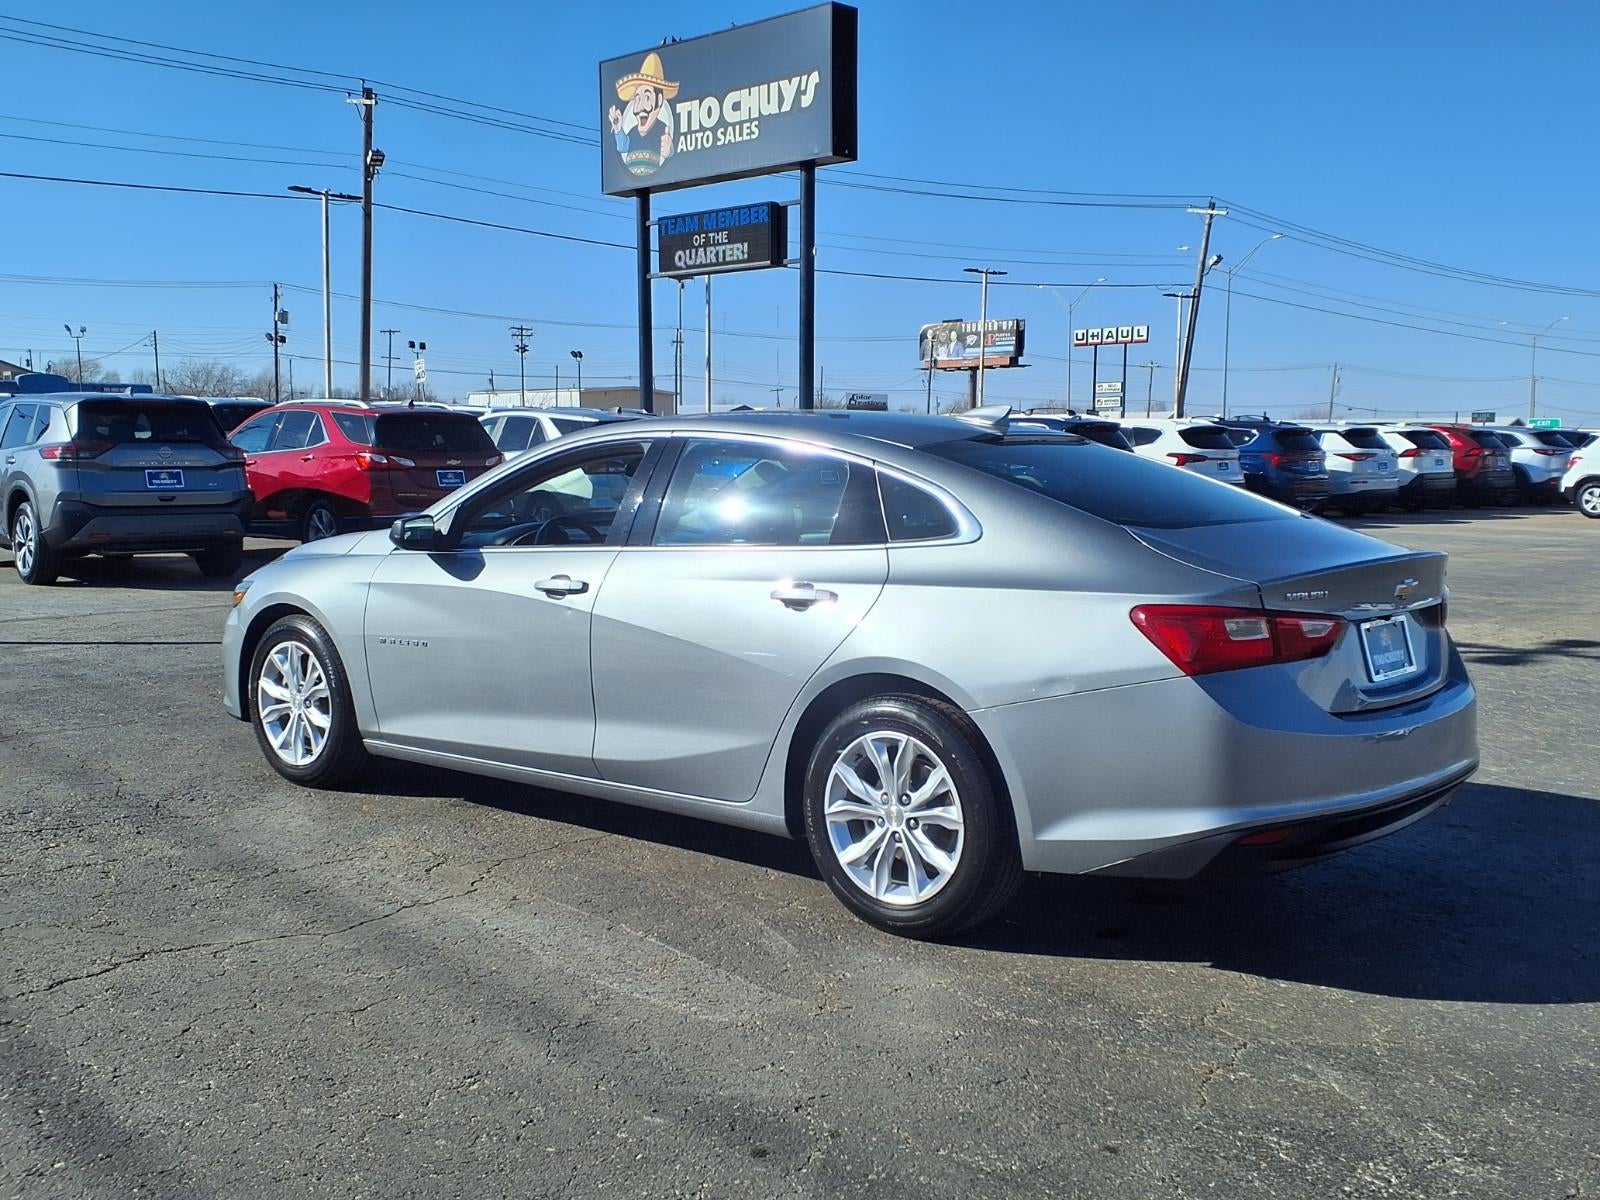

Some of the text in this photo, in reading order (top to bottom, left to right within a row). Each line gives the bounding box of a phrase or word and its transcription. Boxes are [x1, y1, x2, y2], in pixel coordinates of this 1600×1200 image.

[676, 70, 820, 133] TIO CHUY'S
[677, 120, 760, 154] AUTO SALES
[658, 205, 769, 235] TEAM MEMBER
[692, 231, 729, 246] OF THE
[674, 242, 748, 267] QUARTER!
[1286, 590, 1329, 601] MALIBU
